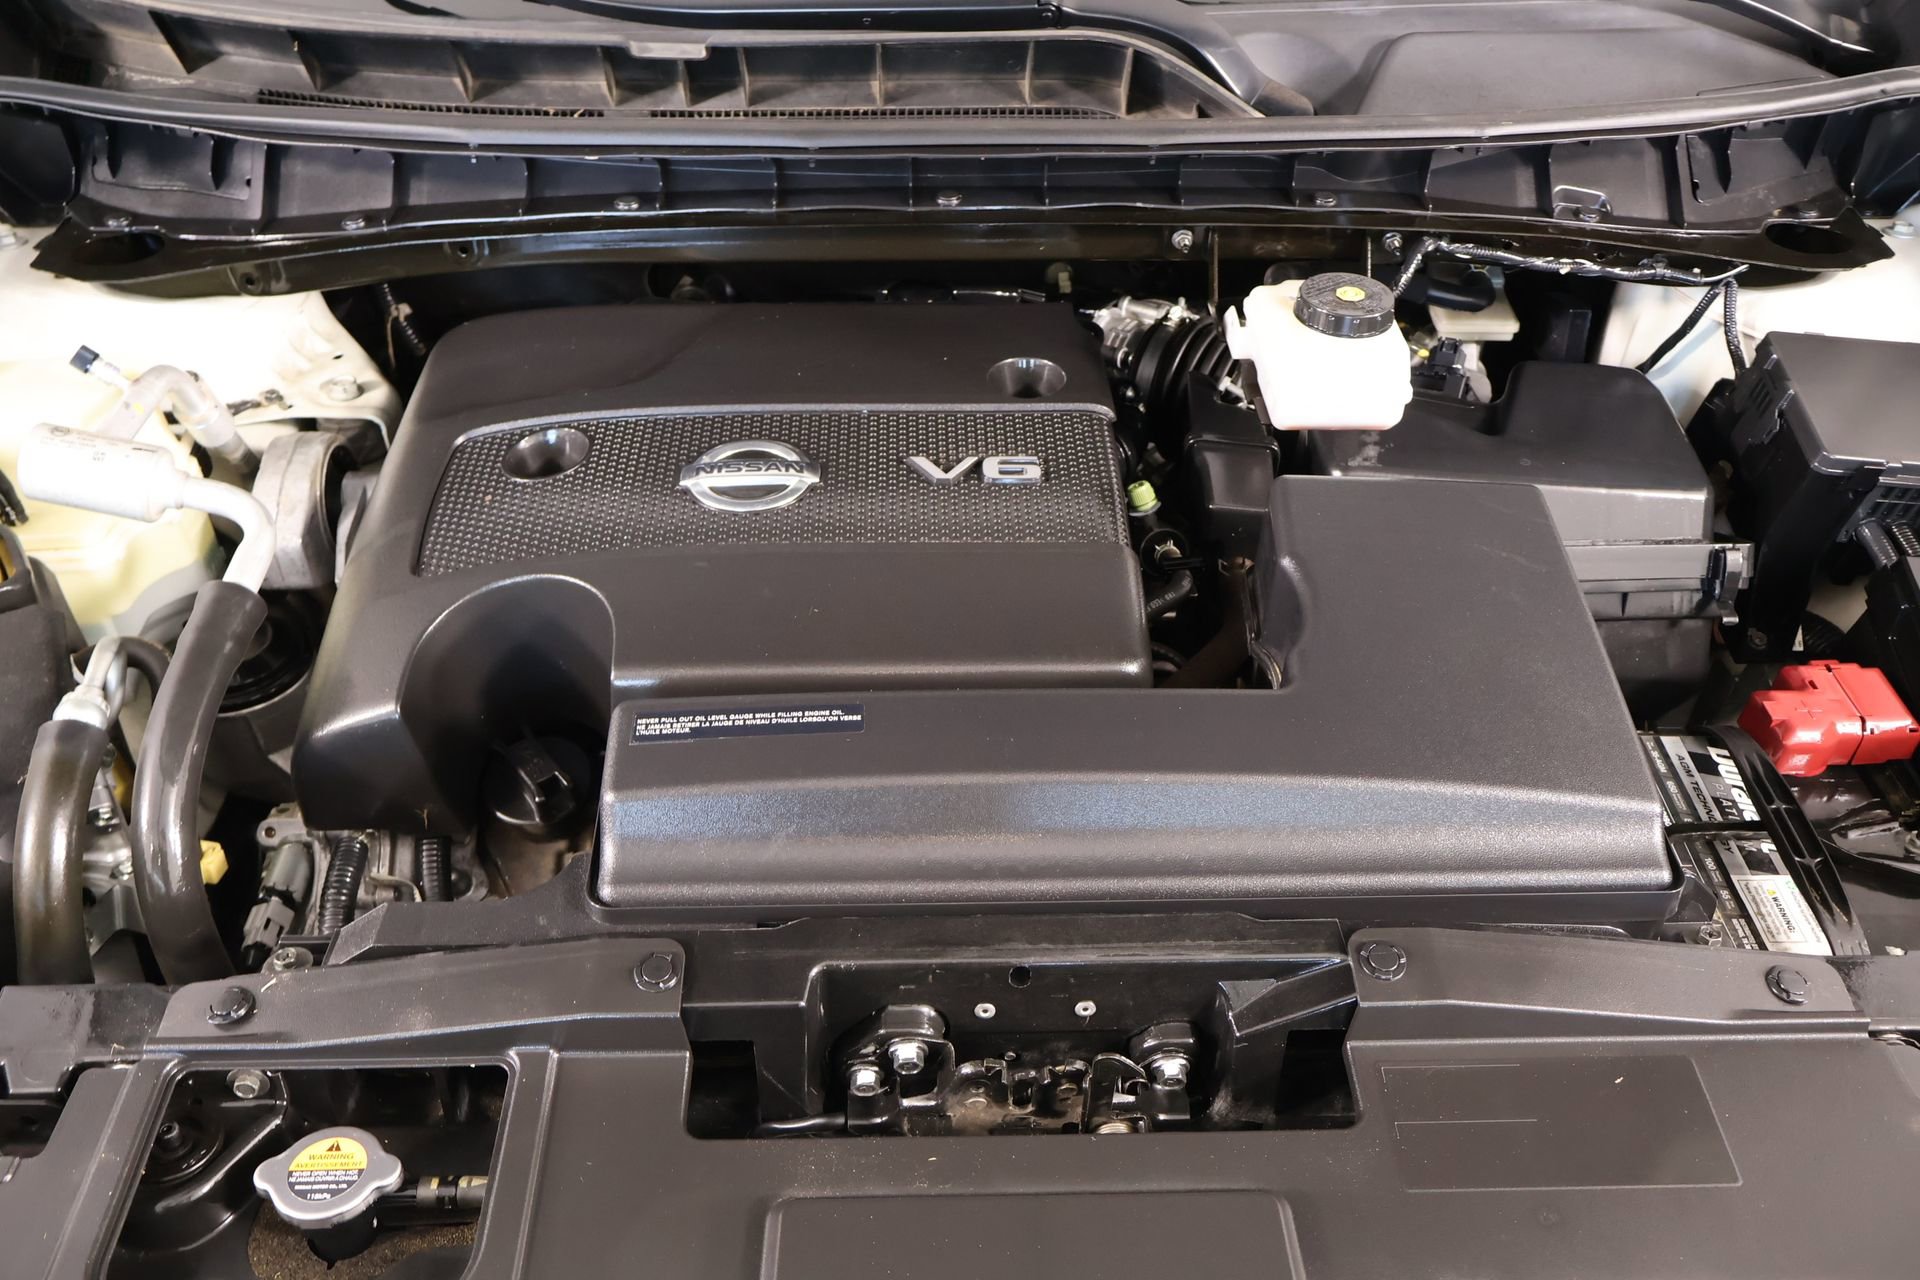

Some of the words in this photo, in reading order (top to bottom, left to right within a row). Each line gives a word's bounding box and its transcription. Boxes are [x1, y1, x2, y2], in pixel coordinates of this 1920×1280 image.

[695, 461, 805, 475] NISSAN
[905, 456, 1042, 486] V6
[1676, 753, 1695, 778] AGM
[1704, 857, 1717, 870] 100
[1720, 889, 1731, 900] 55
[1771, 896, 1796, 934] WARNING:
[308, 1153, 355, 1161] WARNING
[295, 1161, 362, 1169] AVERTISSEMENT
